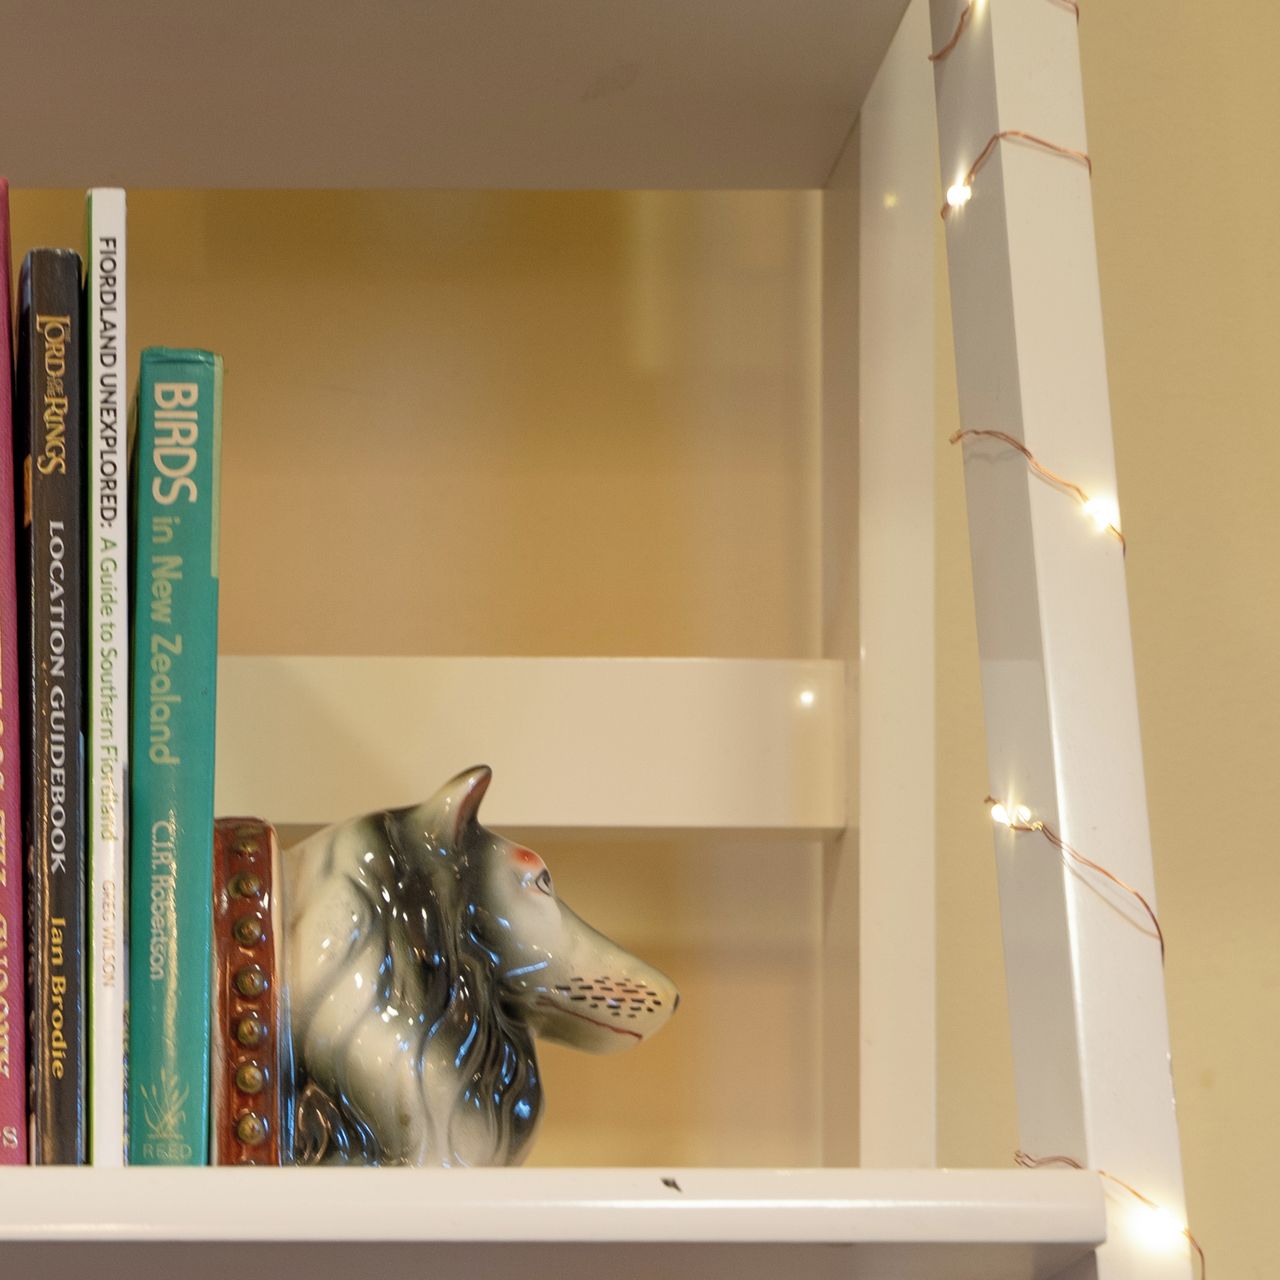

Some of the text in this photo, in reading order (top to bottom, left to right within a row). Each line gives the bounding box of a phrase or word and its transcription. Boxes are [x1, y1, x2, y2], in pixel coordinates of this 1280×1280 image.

[36, 313, 70, 378] LORD
[36, 394, 68, 475] RINGS
[98, 236, 121, 843] FIORDLAND UNEXPLORED: A Guide to Southern Fiordland
[148, 381, 200, 766] BIRDS in New Zealand
[48, 519, 67, 874] LOCATION GUIDEBOOK
[102, 880, 116, 988] GREG WILSON
[150, 875, 176, 980] Robertson
[50, 916, 68, 1081] Ian Brodie
